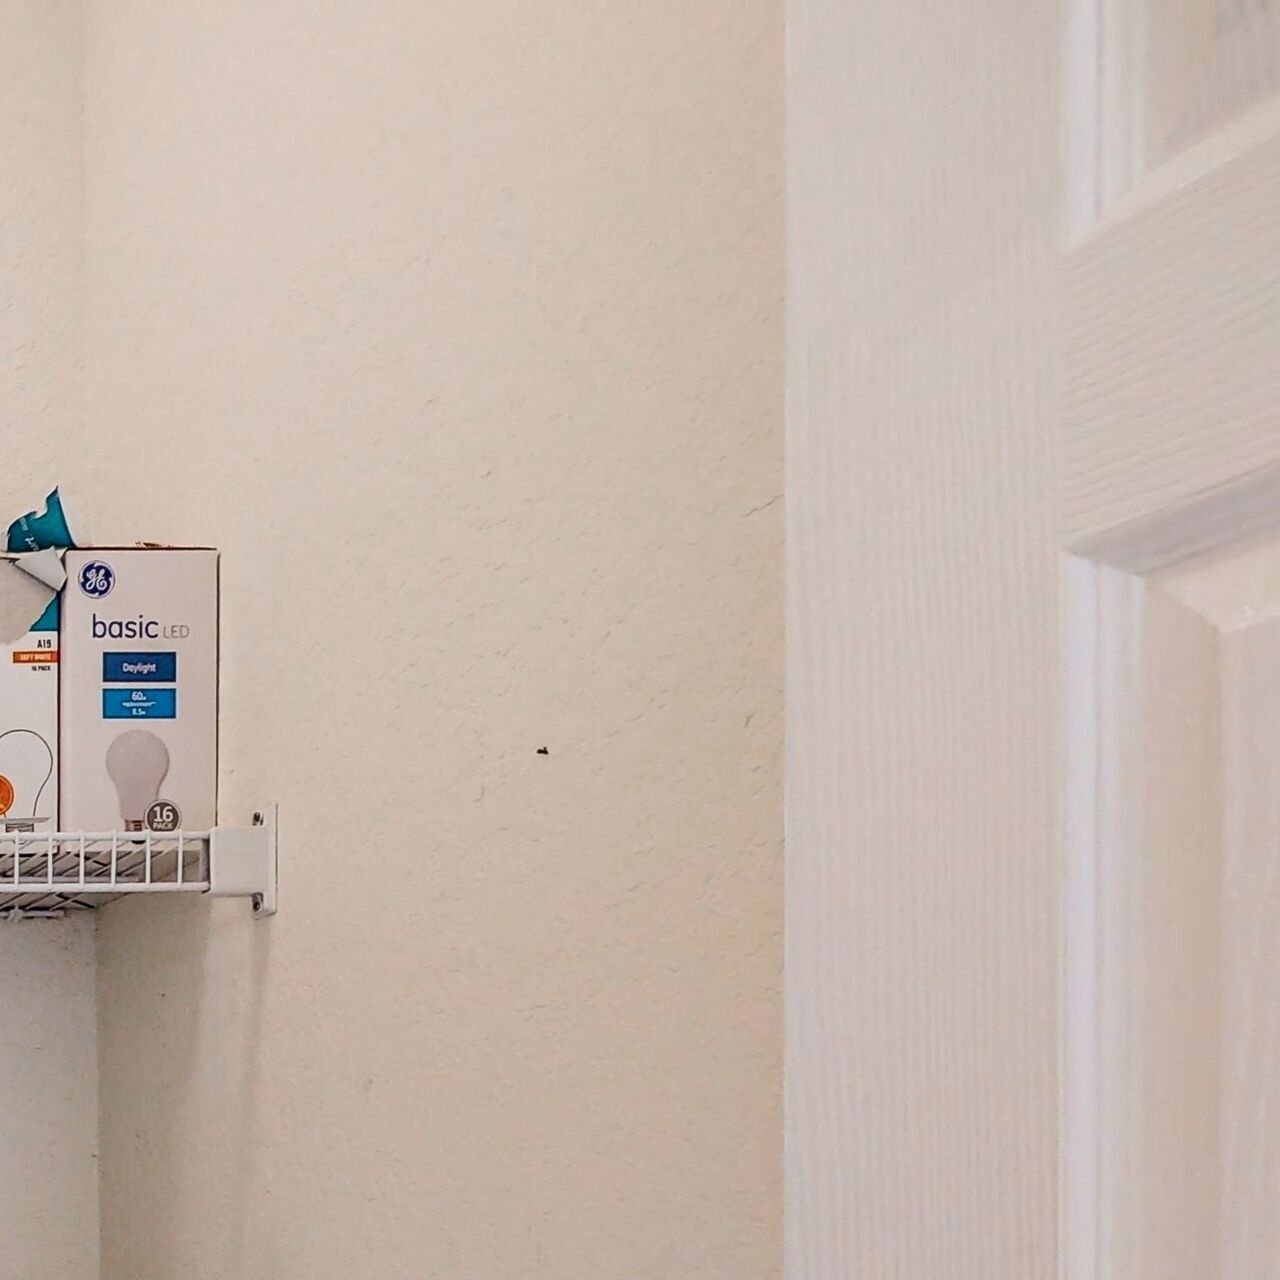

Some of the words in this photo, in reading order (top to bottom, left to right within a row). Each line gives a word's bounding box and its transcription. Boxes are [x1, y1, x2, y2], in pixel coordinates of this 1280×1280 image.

[92, 613, 159, 639] basic
[163, 624, 190, 639] LED
[37, 639, 52, 649] A19
[122, 662, 156, 675] Daylight
[153, 805, 174, 822] 16
